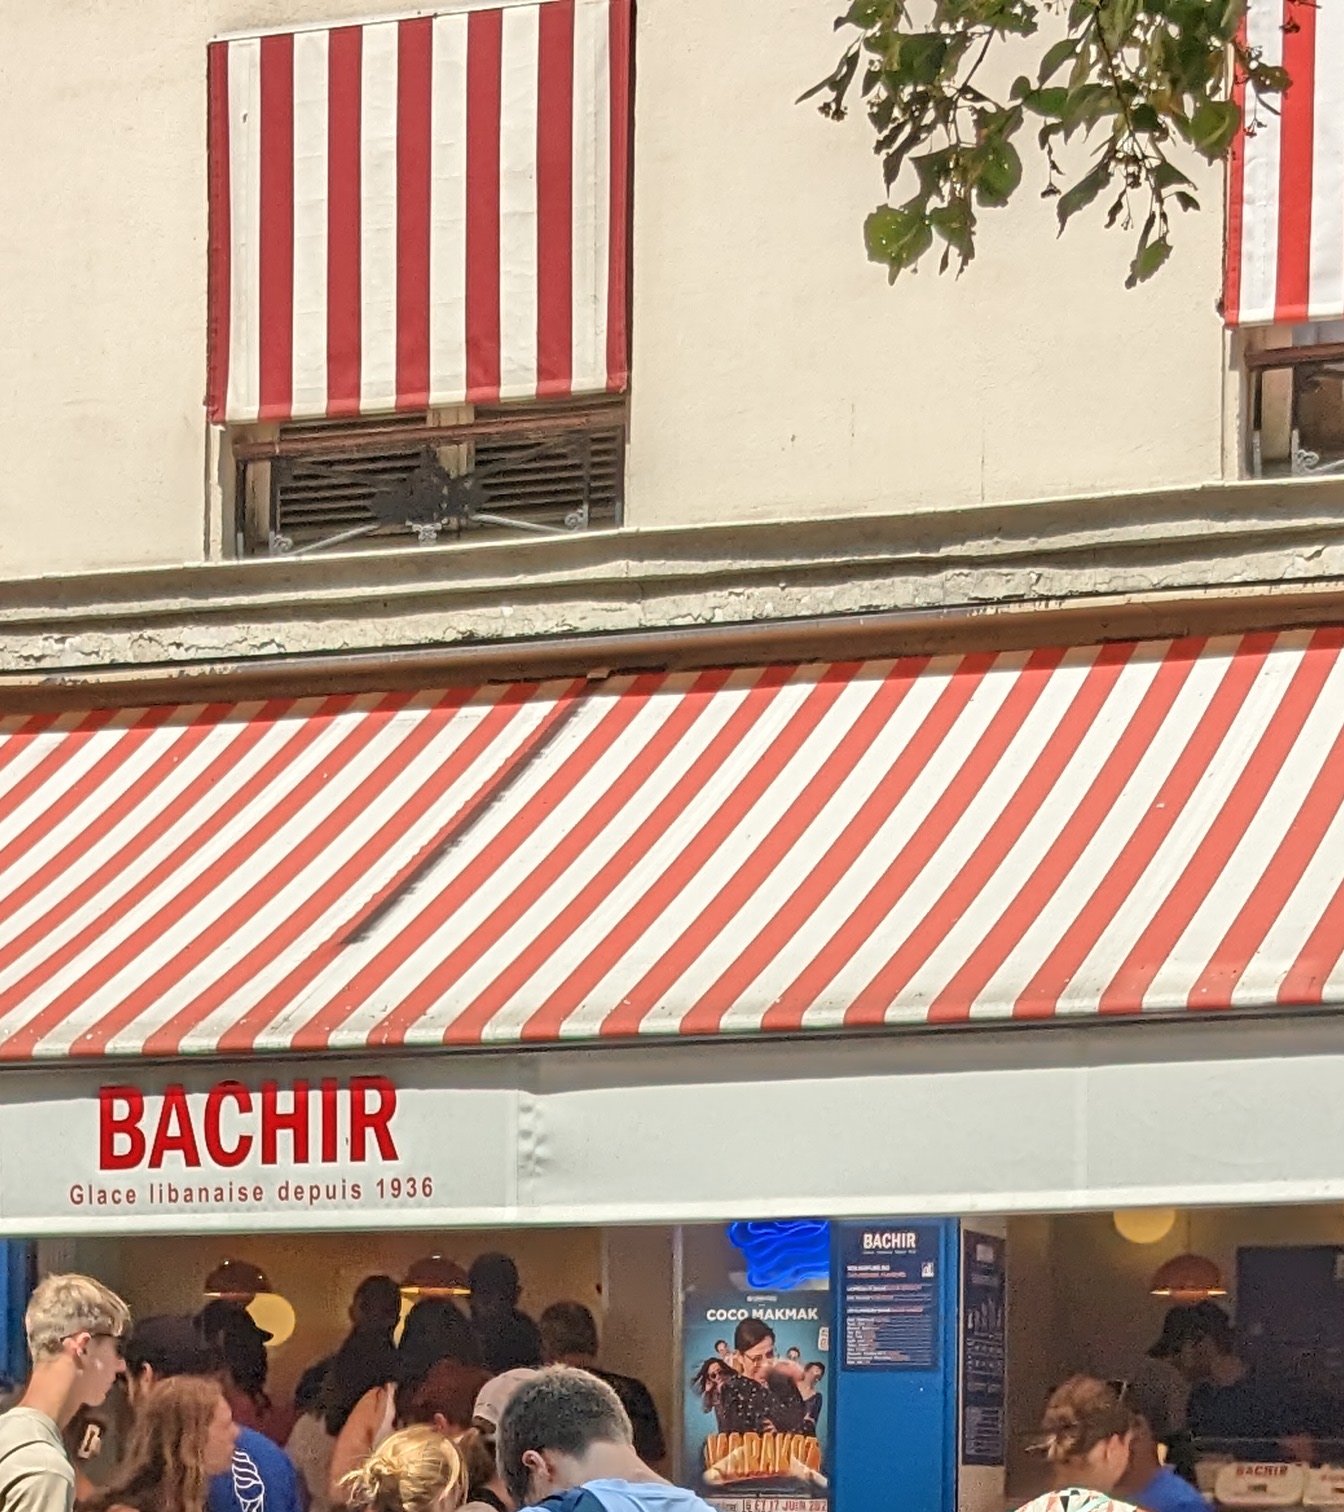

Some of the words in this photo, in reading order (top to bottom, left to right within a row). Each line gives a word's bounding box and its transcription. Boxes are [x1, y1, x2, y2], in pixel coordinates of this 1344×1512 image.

[99, 1074, 400, 1171] BACHIR
[70, 1184, 137, 1206] Glace
[149, 1181, 264, 1204] libanaise
[277, 1178, 362, 1206] depuis
[376, 1176, 434, 1200] 1936
[863, 1232, 916, 1249] BACHIR
[706, 1308, 749, 1321] COCO
[751, 1307, 819, 1321] MAKMAK
